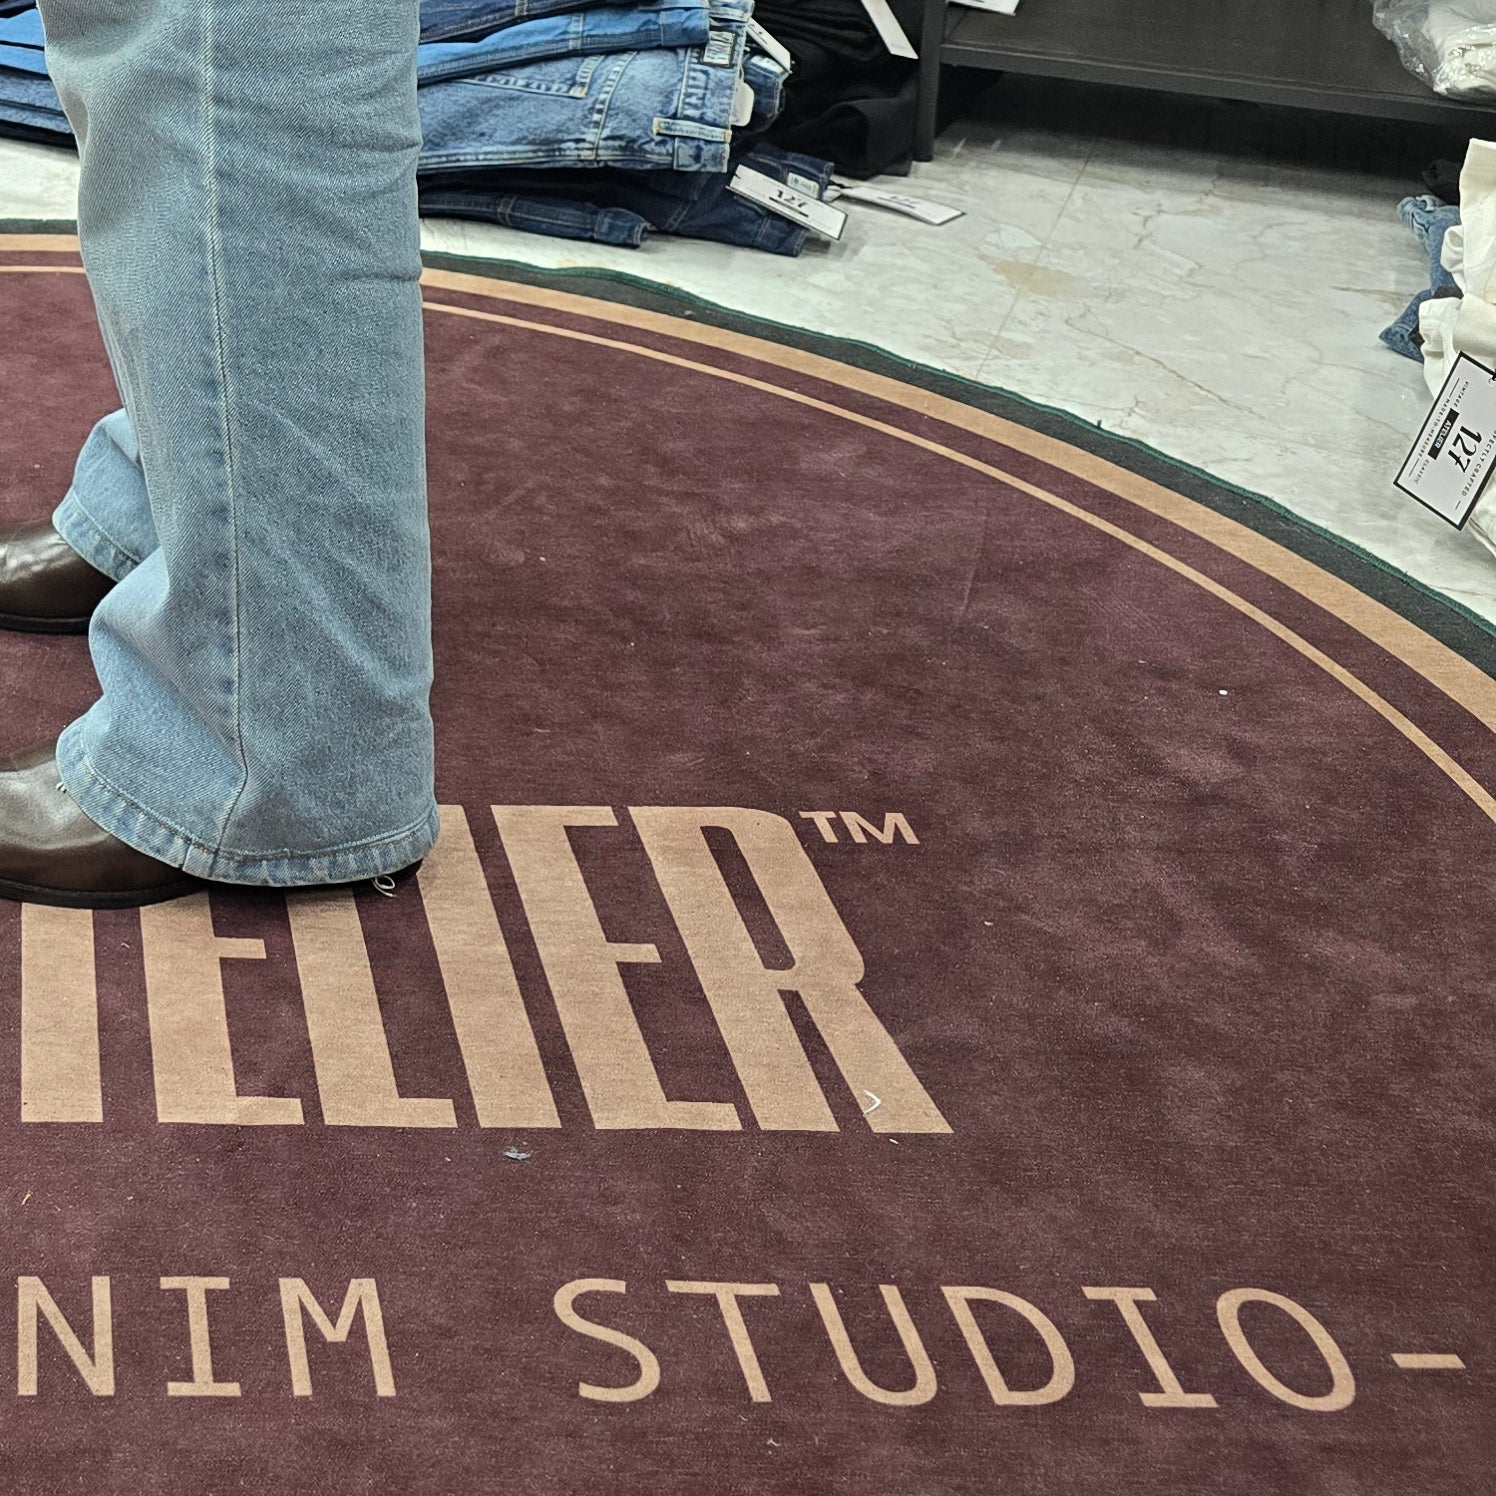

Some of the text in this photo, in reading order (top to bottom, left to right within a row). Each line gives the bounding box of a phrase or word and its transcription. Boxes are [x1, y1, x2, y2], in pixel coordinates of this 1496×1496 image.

[776, 188, 808, 209] 127
[1453, 381, 1470, 408] VINTAGE
[1447, 425, 1483, 474] 127
[1461, 463, 1483, 497] CRAFTED
